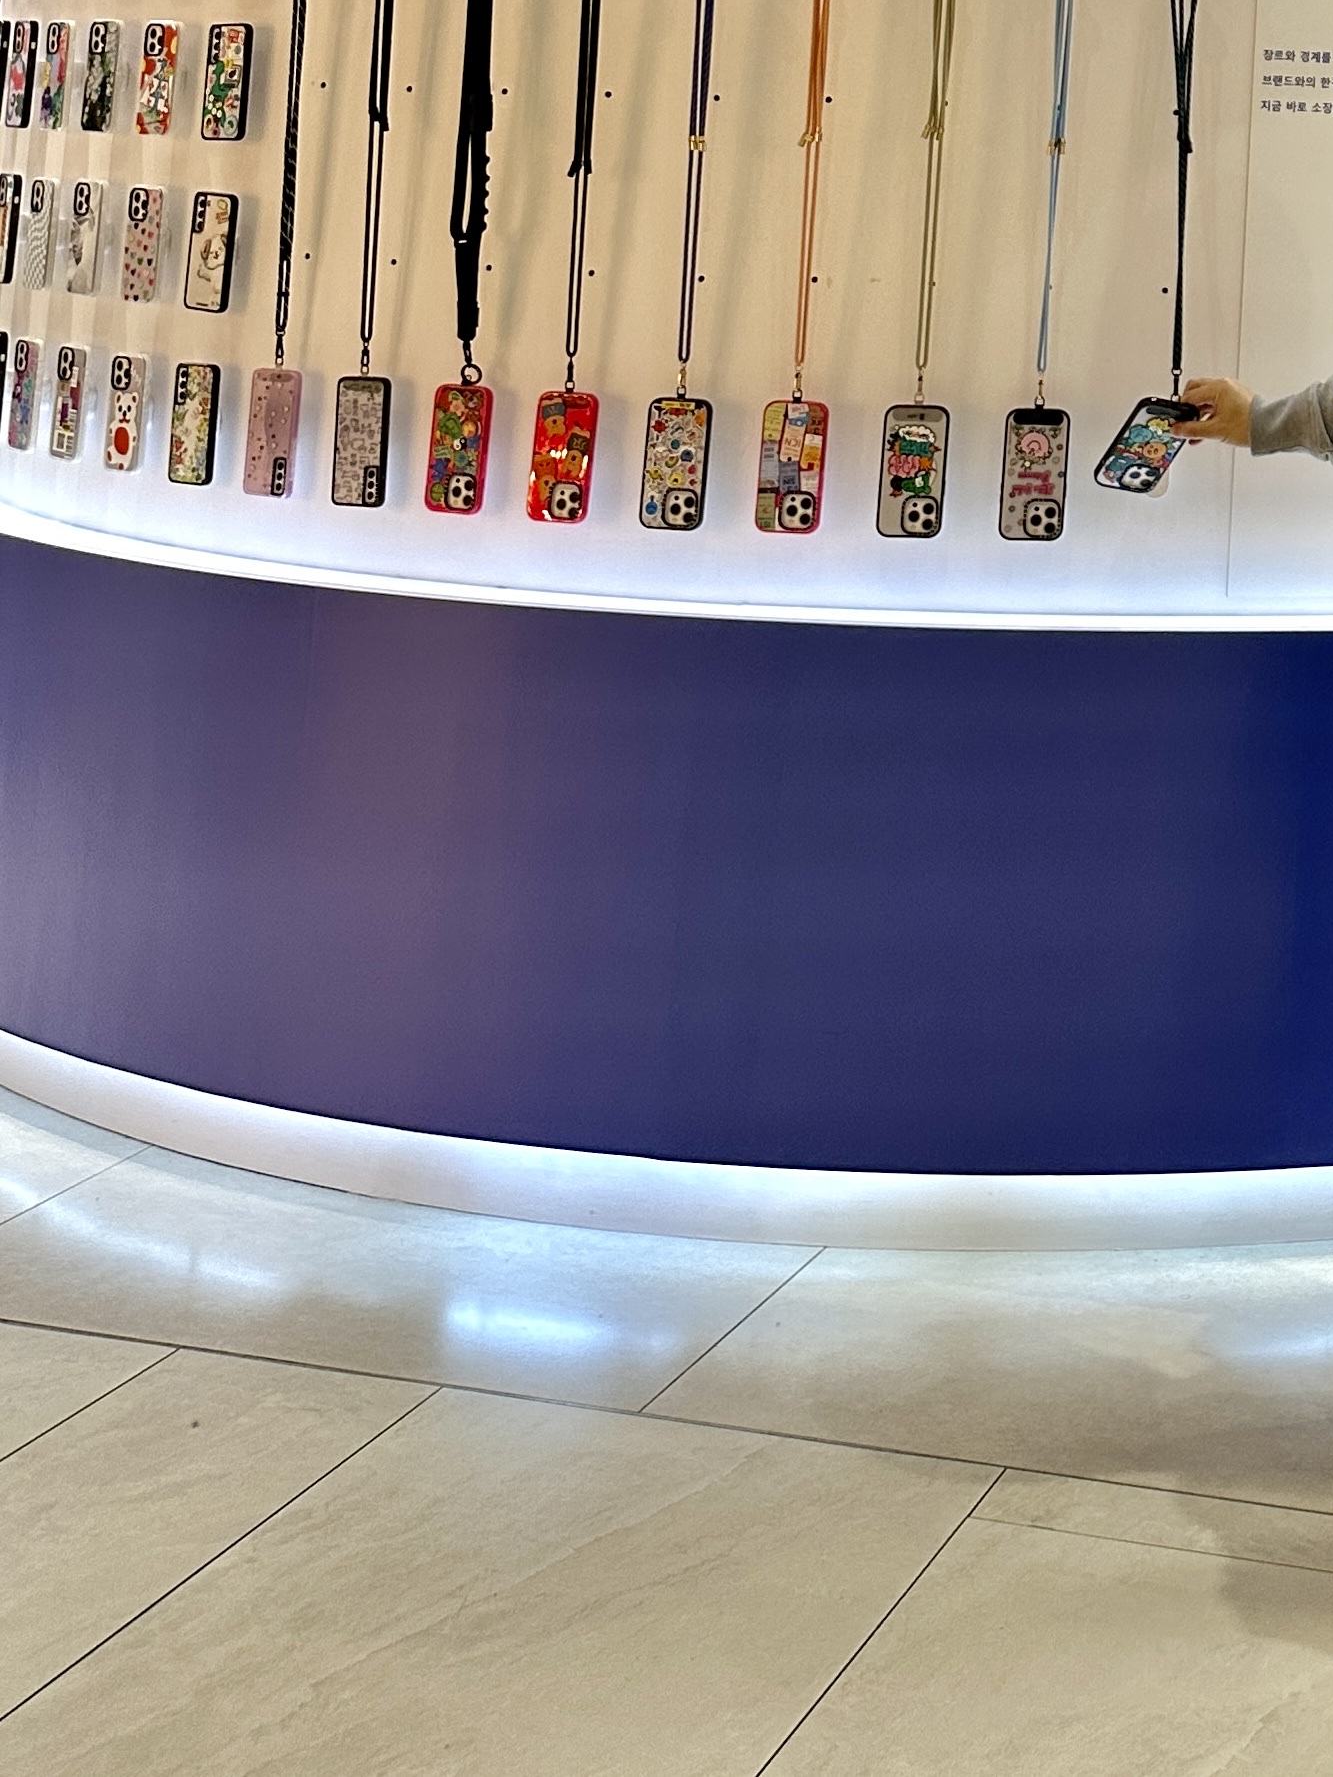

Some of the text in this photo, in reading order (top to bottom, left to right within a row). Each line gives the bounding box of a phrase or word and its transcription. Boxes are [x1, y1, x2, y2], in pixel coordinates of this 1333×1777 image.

[1263, 49, 1295, 62] 장르와
[1300, 50, 1332, 63] 경계를
[1262, 74, 1316, 88] 브랜드와의
[1261, 99, 1281, 112] 지금
[1286, 101, 1307, 113] 바로
